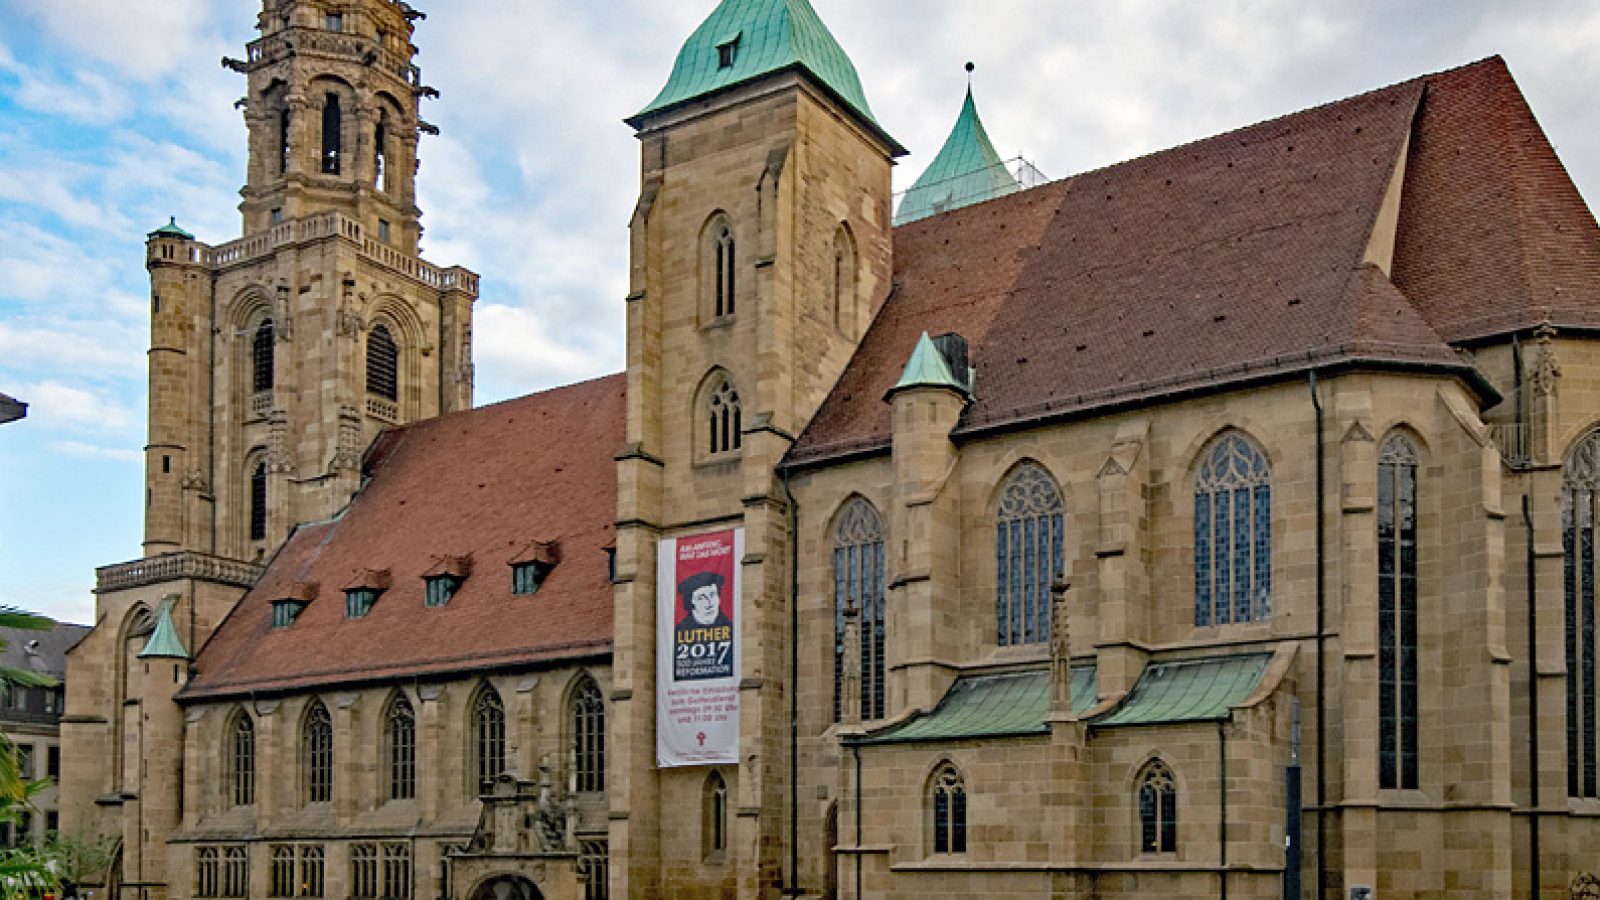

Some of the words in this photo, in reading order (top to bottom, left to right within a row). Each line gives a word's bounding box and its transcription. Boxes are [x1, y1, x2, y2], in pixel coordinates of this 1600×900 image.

[677, 626, 730, 643] LUTHER
[677, 641, 731, 665] 2017
[676, 665, 730, 677] REFORMATION
